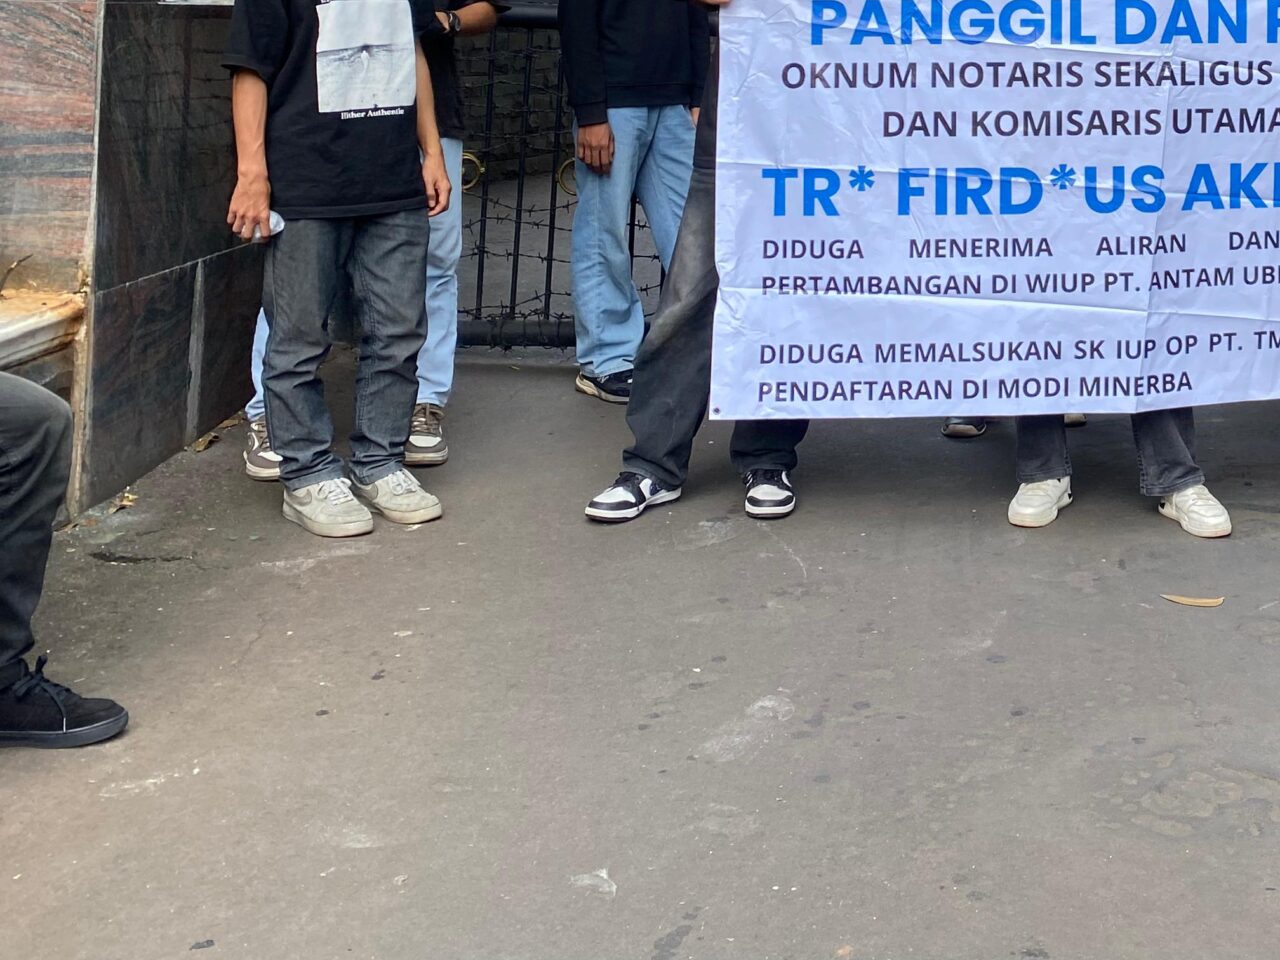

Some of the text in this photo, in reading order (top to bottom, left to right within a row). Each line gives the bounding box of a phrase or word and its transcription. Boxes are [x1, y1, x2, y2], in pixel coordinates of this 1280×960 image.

[781, 62, 917, 89] OKNUM
[931, 61, 1083, 88] NOTARIS
[1094, 60, 1273, 88] SEKALIGUS
[883, 111, 957, 137] DAN
[971, 109, 1162, 137] KOMISARIS
[763, 239, 864, 259] DIDUGA
[909, 237, 1053, 259] MENERIMA
[1096, 234, 1186, 256] ALIRAN
[762, 275, 981, 295] PERTAMBANGAN
[992, 275, 1016, 294] DI
[1025, 273, 1095, 293] WIUP
[1104, 272, 1141, 292] PT.
[1148, 268, 1235, 292] ANTAM
[760, 343, 863, 364] DIDUGA
[875, 341, 1062, 363] MEMALSUKAN
[1074, 340, 1105, 360] SK
[1116, 339, 1156, 360] IUP
[1166, 335, 1198, 356] OP
[1209, 332, 1243, 353] PT.
[758, 371, 1193, 402] PENDAFTARAN DI MODI MINERBA
